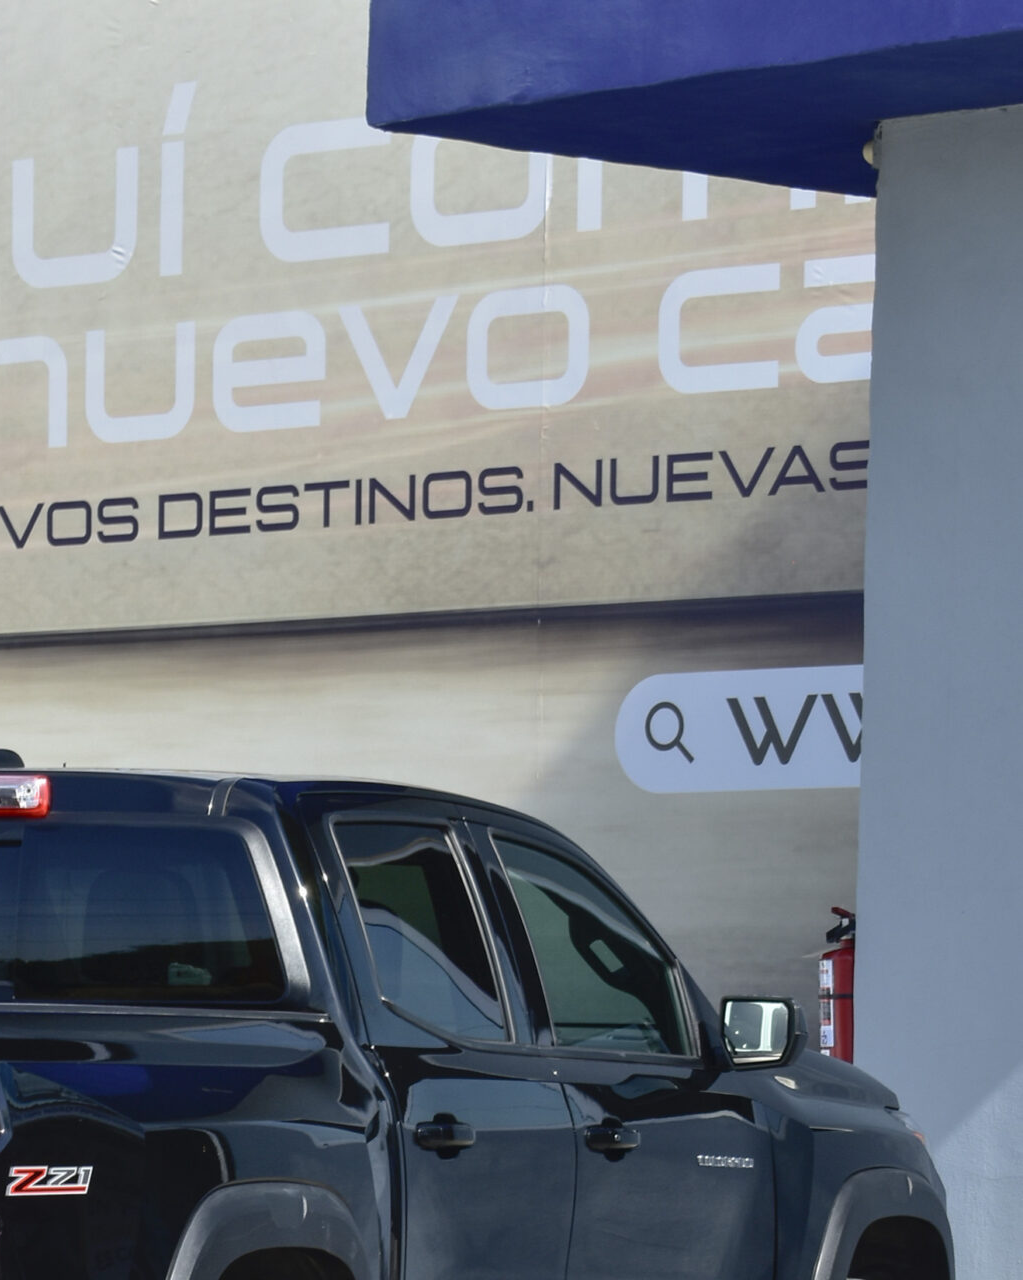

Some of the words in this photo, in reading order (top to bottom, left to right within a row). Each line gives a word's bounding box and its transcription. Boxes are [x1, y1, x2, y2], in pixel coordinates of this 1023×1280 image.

[158, 465, 534, 540] DESTINOS.
[553, 440, 870, 510] NUEVAS
[5, 1166, 93, 1196] Z71
